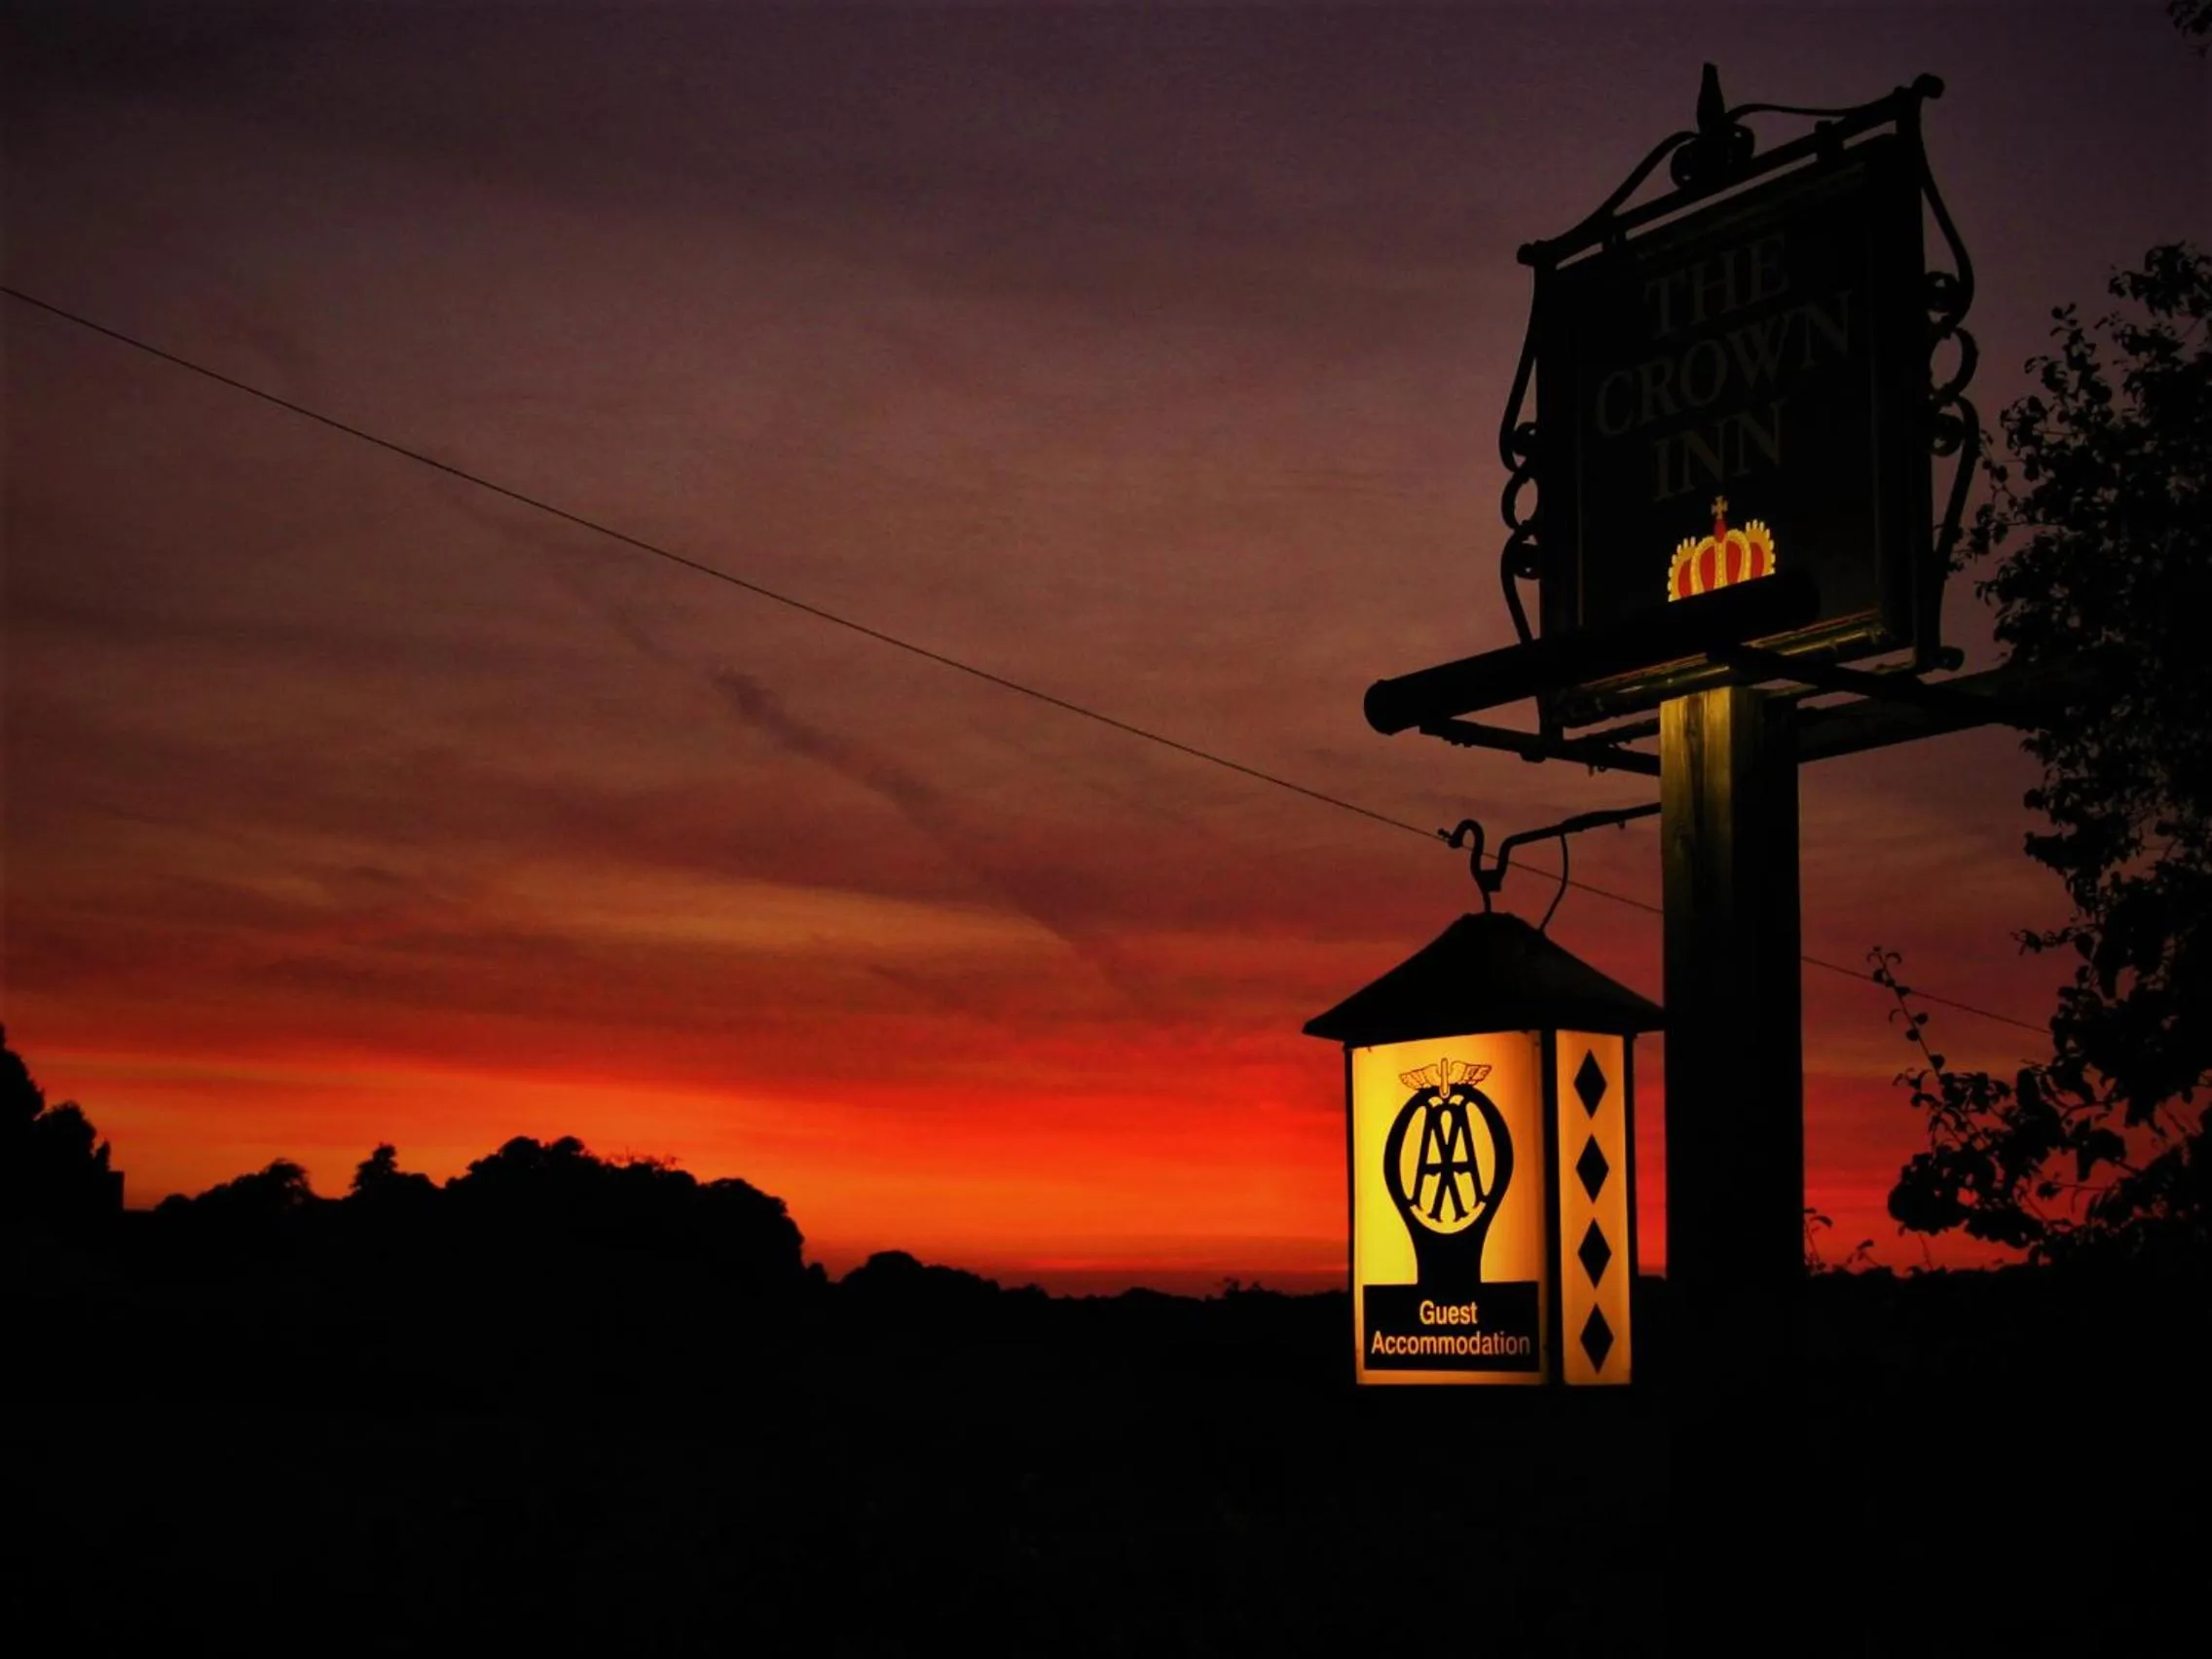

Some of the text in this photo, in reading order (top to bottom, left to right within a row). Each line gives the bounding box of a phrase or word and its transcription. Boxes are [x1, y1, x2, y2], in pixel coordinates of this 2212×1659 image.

[1642, 231, 1789, 341] THE
[1595, 288, 1854, 438] CROWN
[1652, 395, 1788, 503] INN
[1370, 1329, 1531, 1356] Accommodation
[1419, 1298, 1479, 1326] Guest
